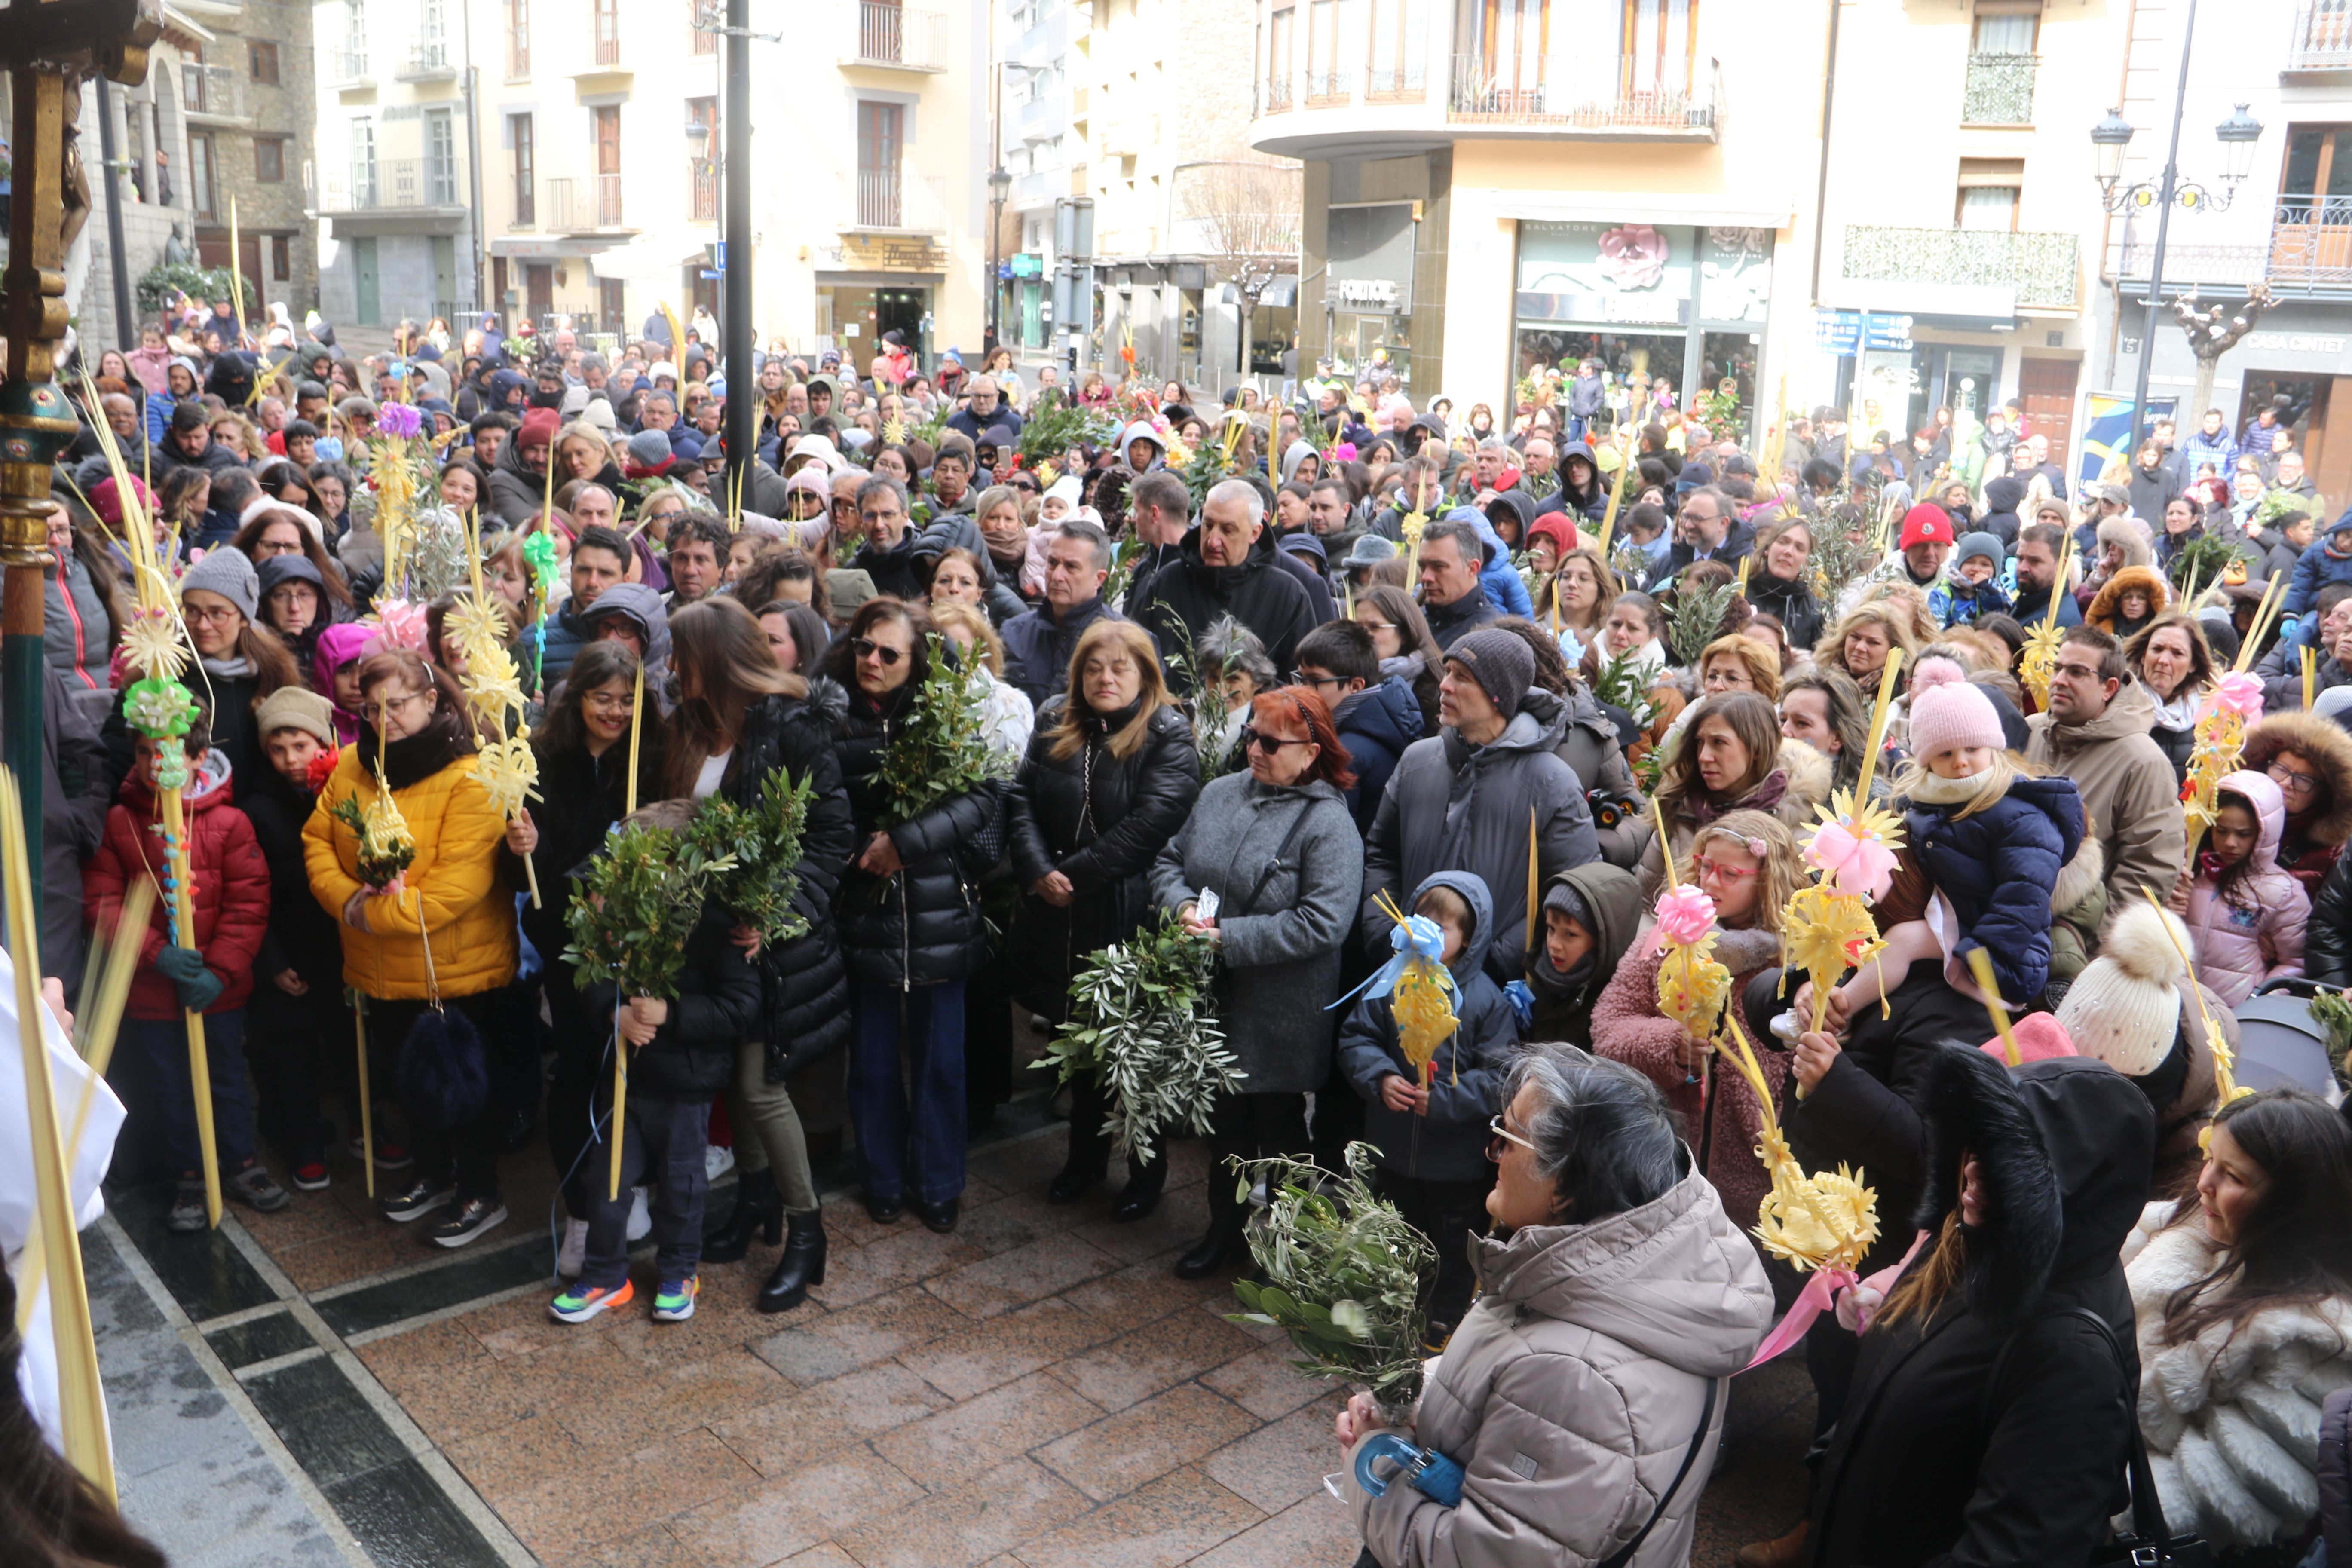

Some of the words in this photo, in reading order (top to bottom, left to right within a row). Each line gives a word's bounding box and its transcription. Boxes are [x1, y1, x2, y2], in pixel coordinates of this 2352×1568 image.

[1525, 224, 1596, 232] SALVATORE
[2126, 341, 2134, 352] 5
[2247, 334, 2288, 351] CASA
[2289, 335, 2347, 353] CINTET
